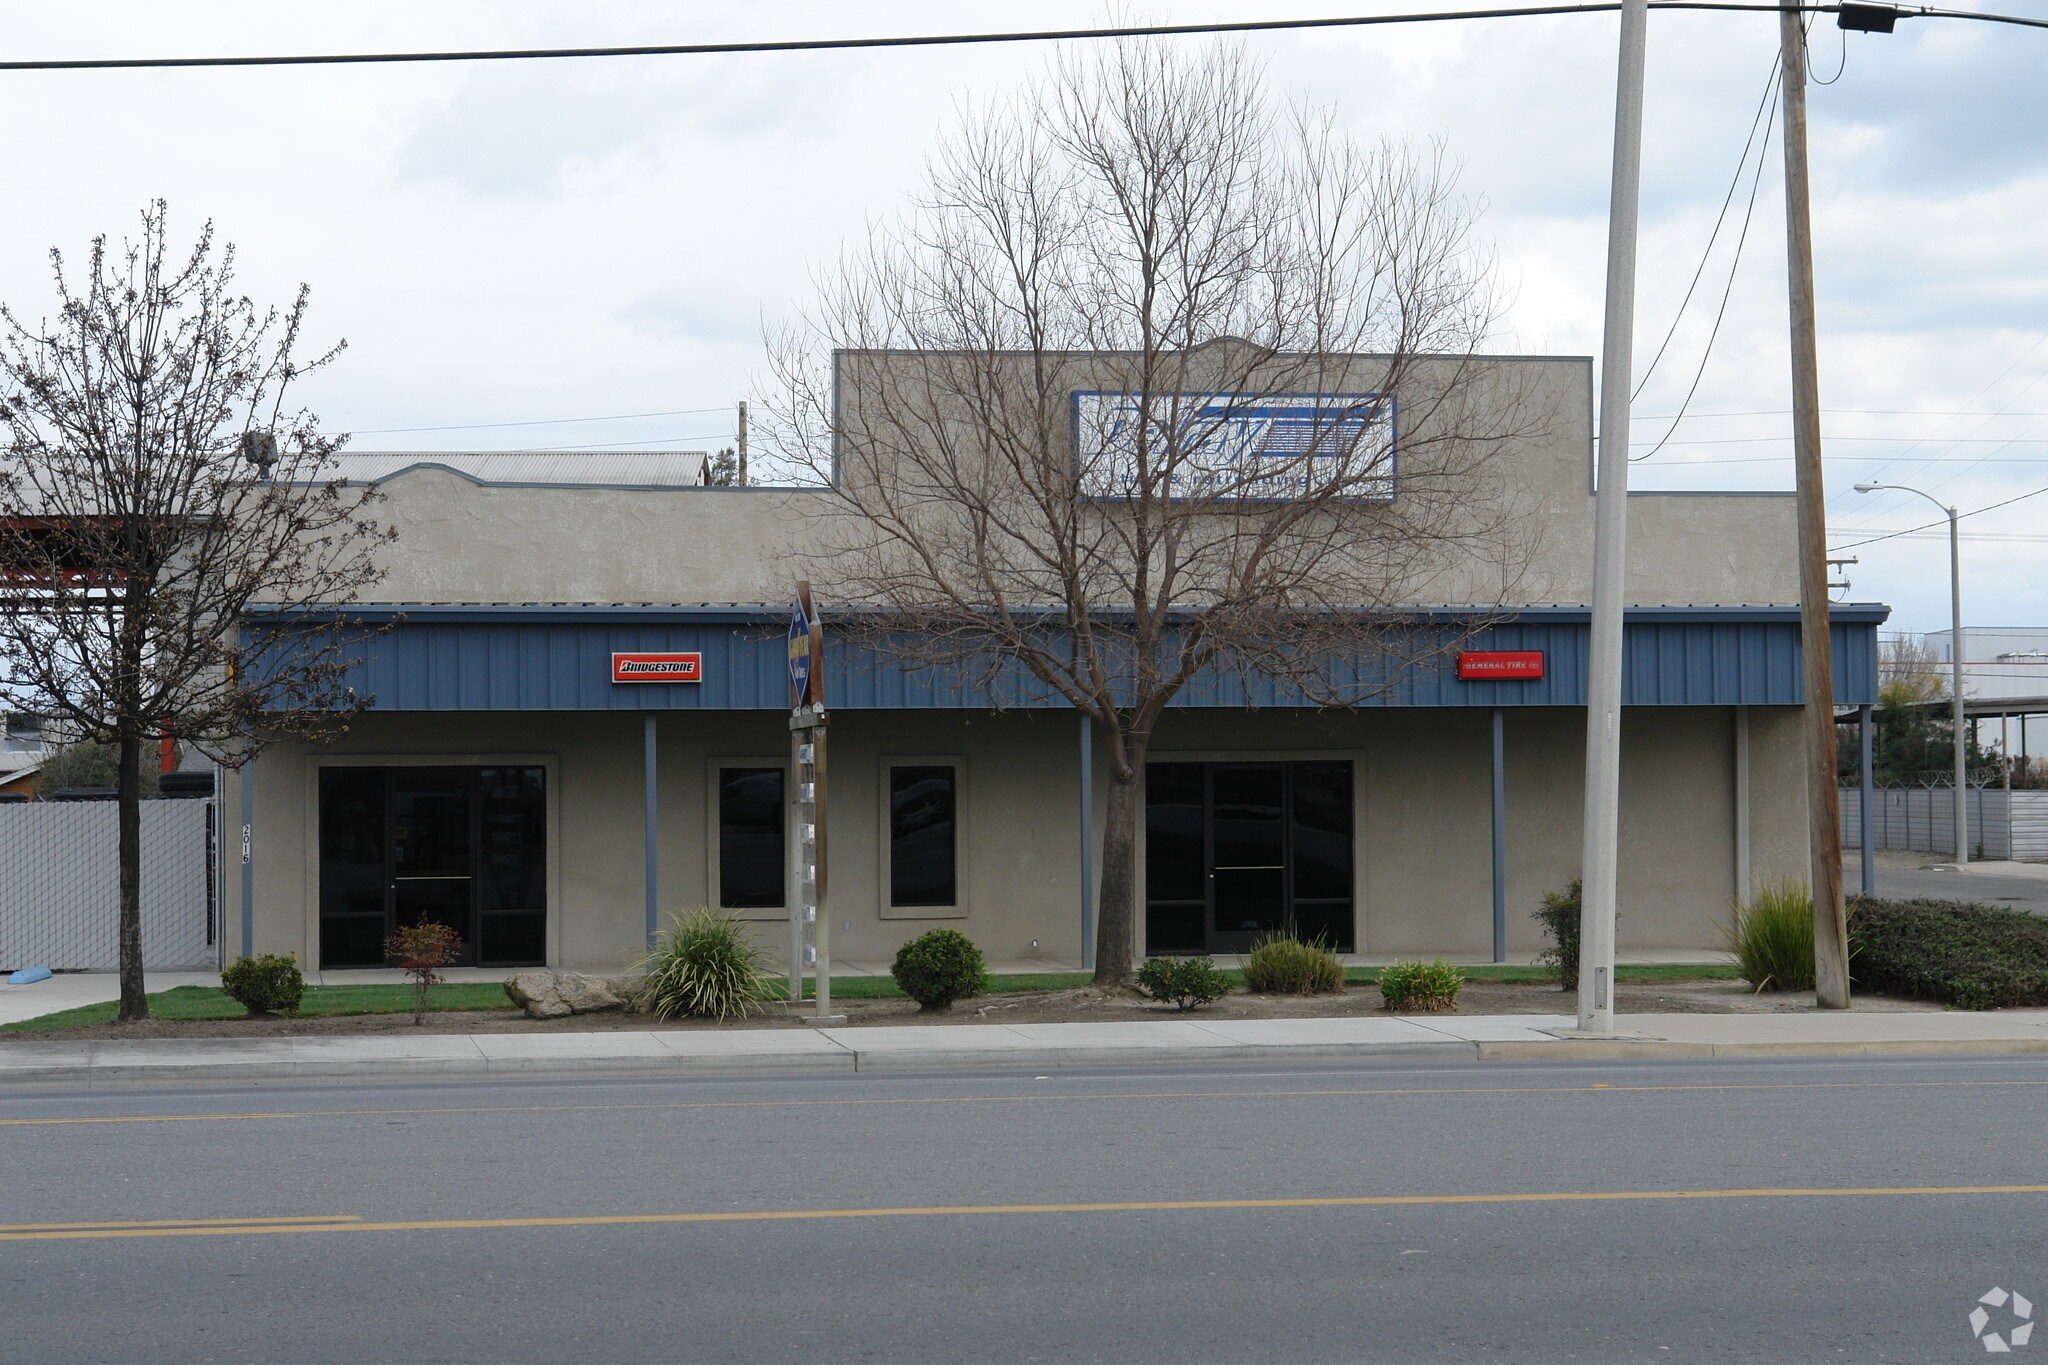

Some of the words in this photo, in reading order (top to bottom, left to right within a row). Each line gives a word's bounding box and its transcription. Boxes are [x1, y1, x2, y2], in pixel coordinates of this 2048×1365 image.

[619, 660, 694, 673] BRIDGESTONE
[1465, 661, 1504, 670] GENERAL
[1507, 661, 1526, 669] TIRE
